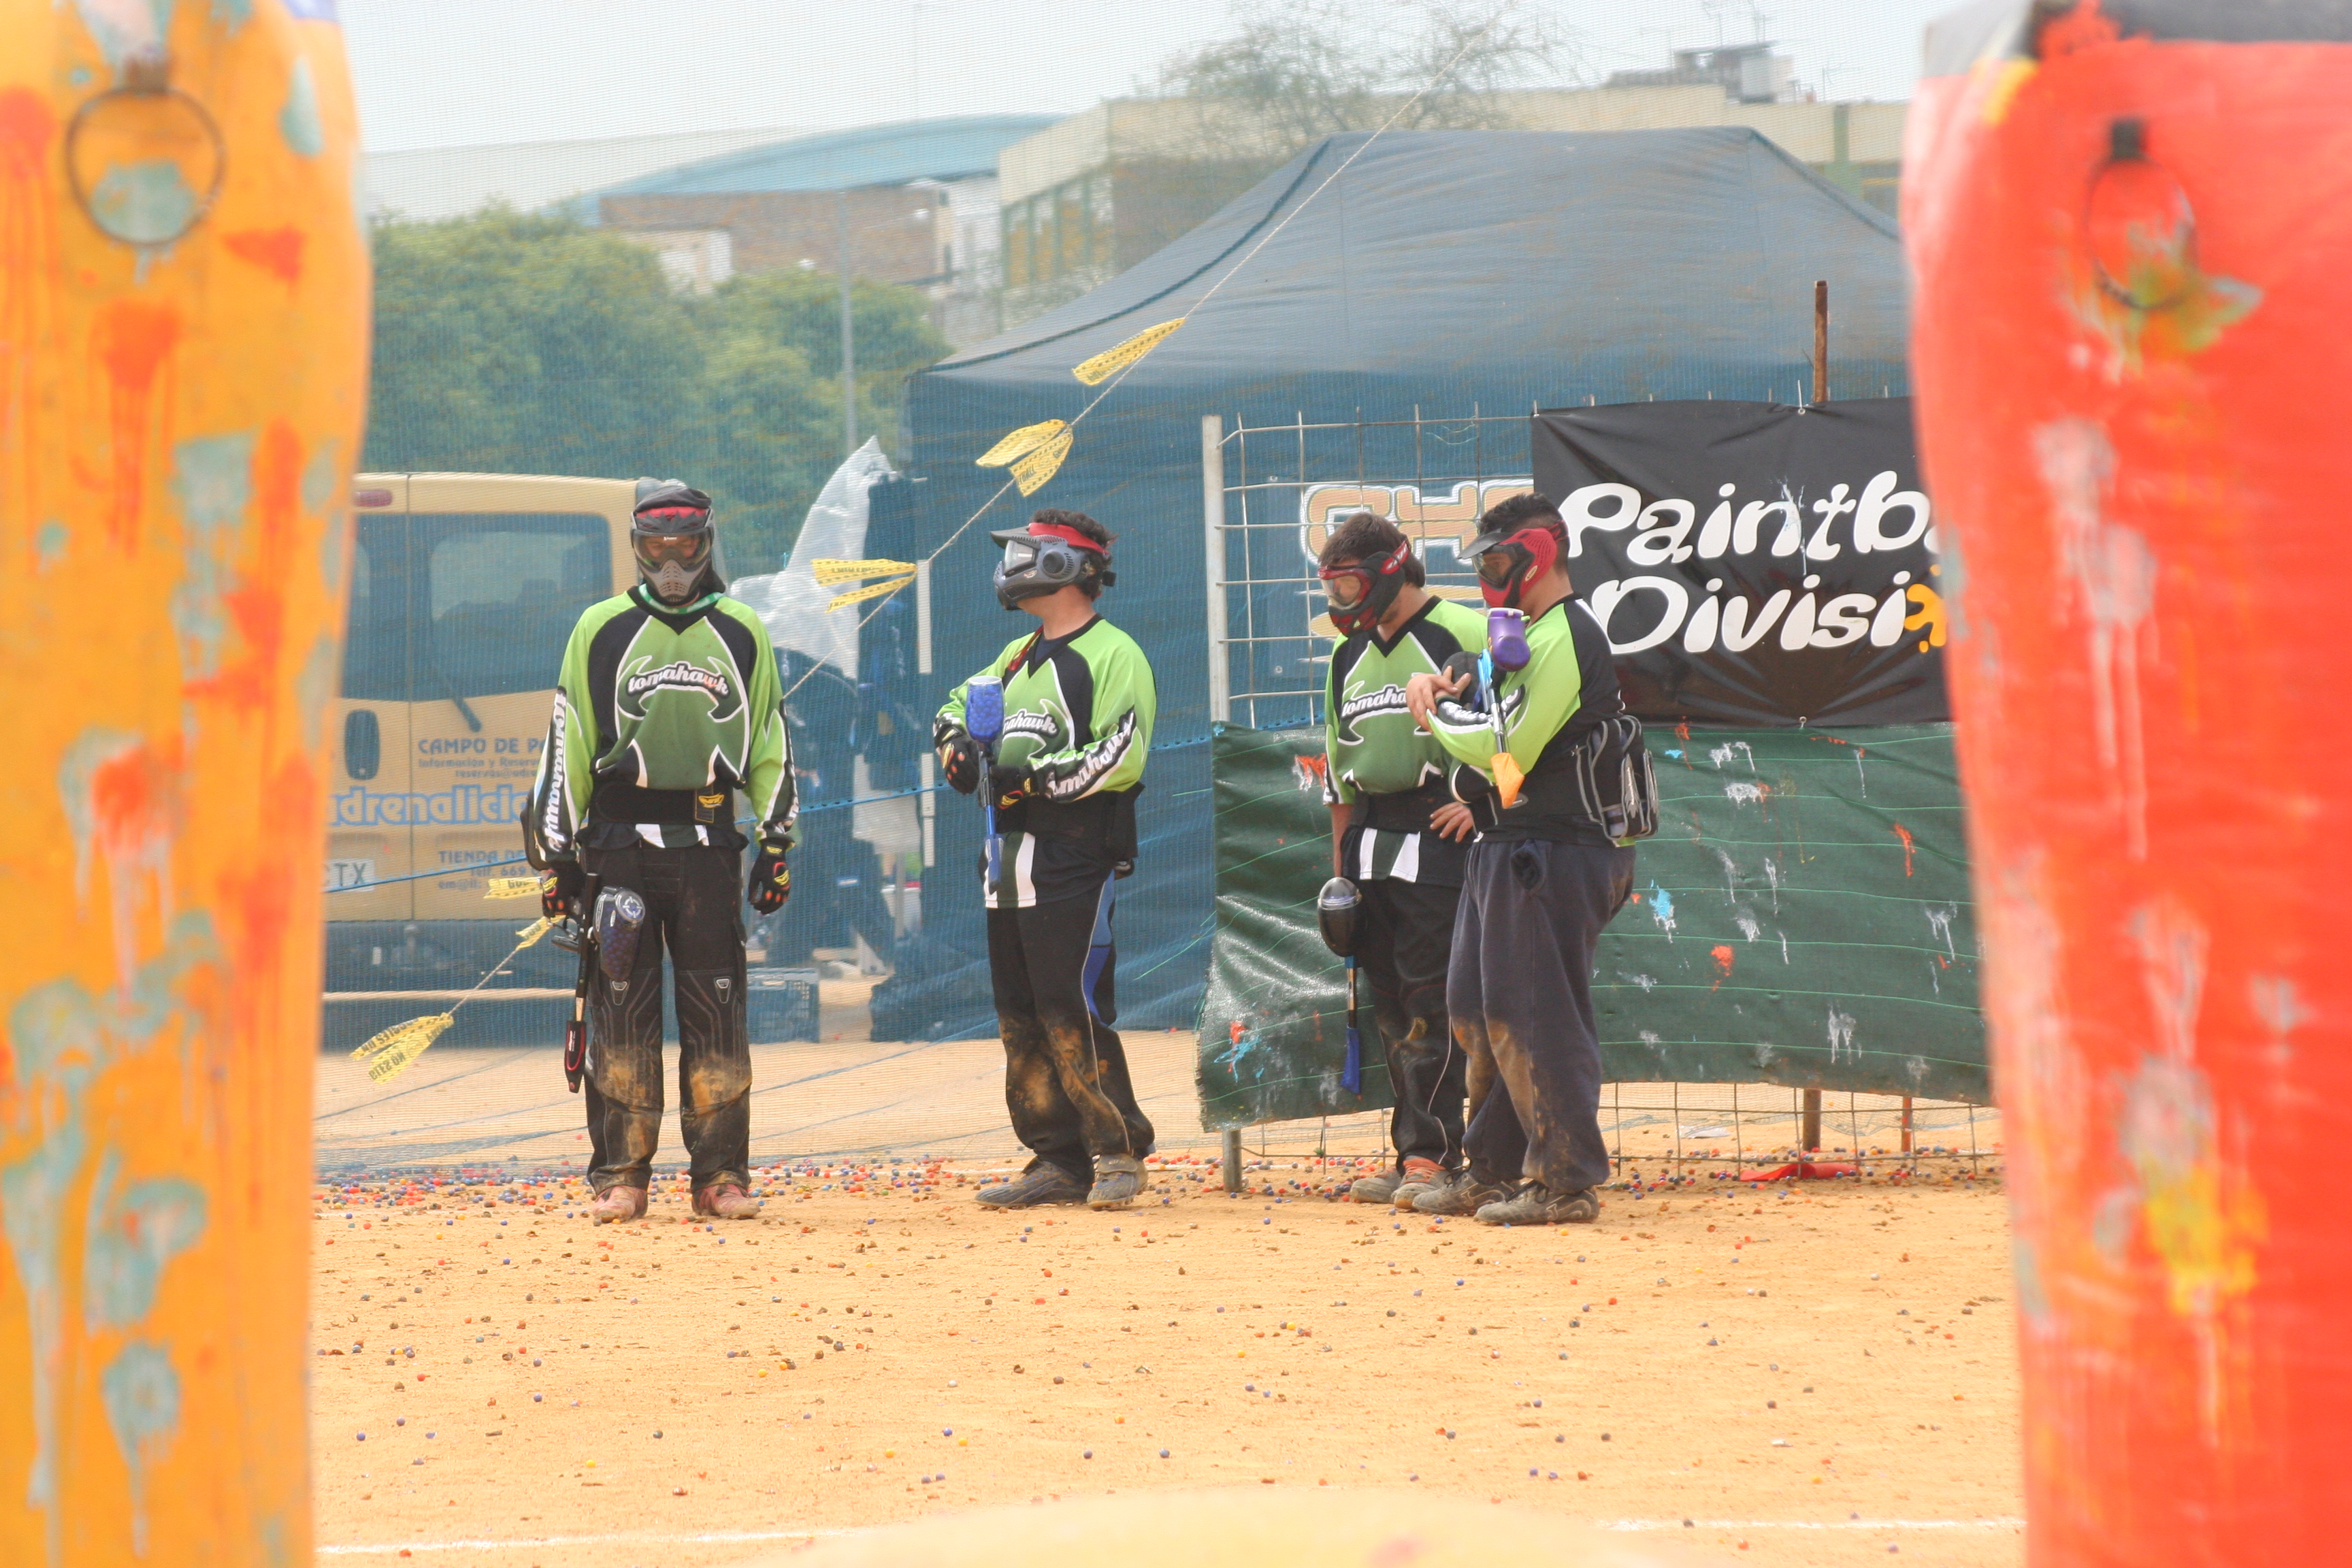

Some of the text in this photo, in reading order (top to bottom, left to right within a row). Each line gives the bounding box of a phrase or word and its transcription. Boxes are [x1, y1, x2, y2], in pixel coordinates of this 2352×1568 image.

[1557, 470, 1939, 566] Paintb
[1590, 570, 1948, 655] Divisi
[627, 664, 730, 696] tomahawk
[1342, 687, 1407, 717] tomaha
[417, 737, 487, 755] CAMPO
[494, 737, 520, 753] DE
